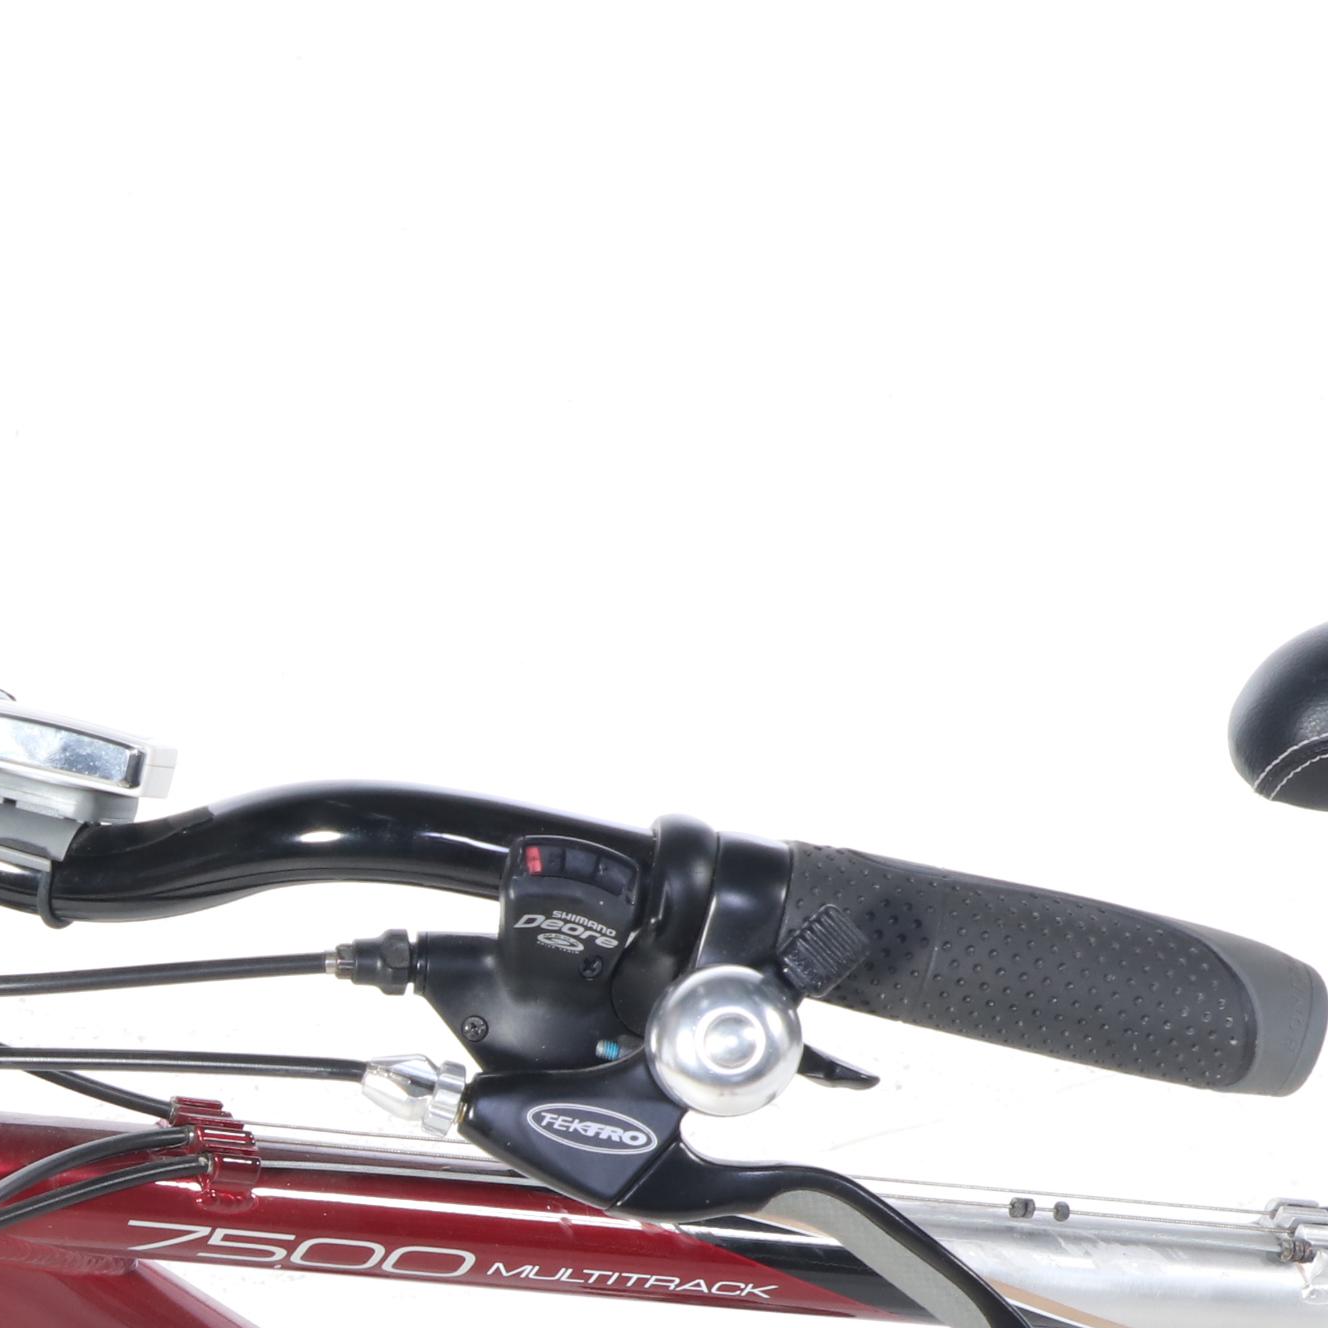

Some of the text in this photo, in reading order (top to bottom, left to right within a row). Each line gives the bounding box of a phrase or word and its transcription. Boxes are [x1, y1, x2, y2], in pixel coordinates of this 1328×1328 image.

[513, 914, 619, 948] Deore
[552, 910, 617, 937] SHIMANO
[540, 1112, 647, 1146] TEKTRO
[128, 1219, 778, 1298] 7500 MULTITRACK
